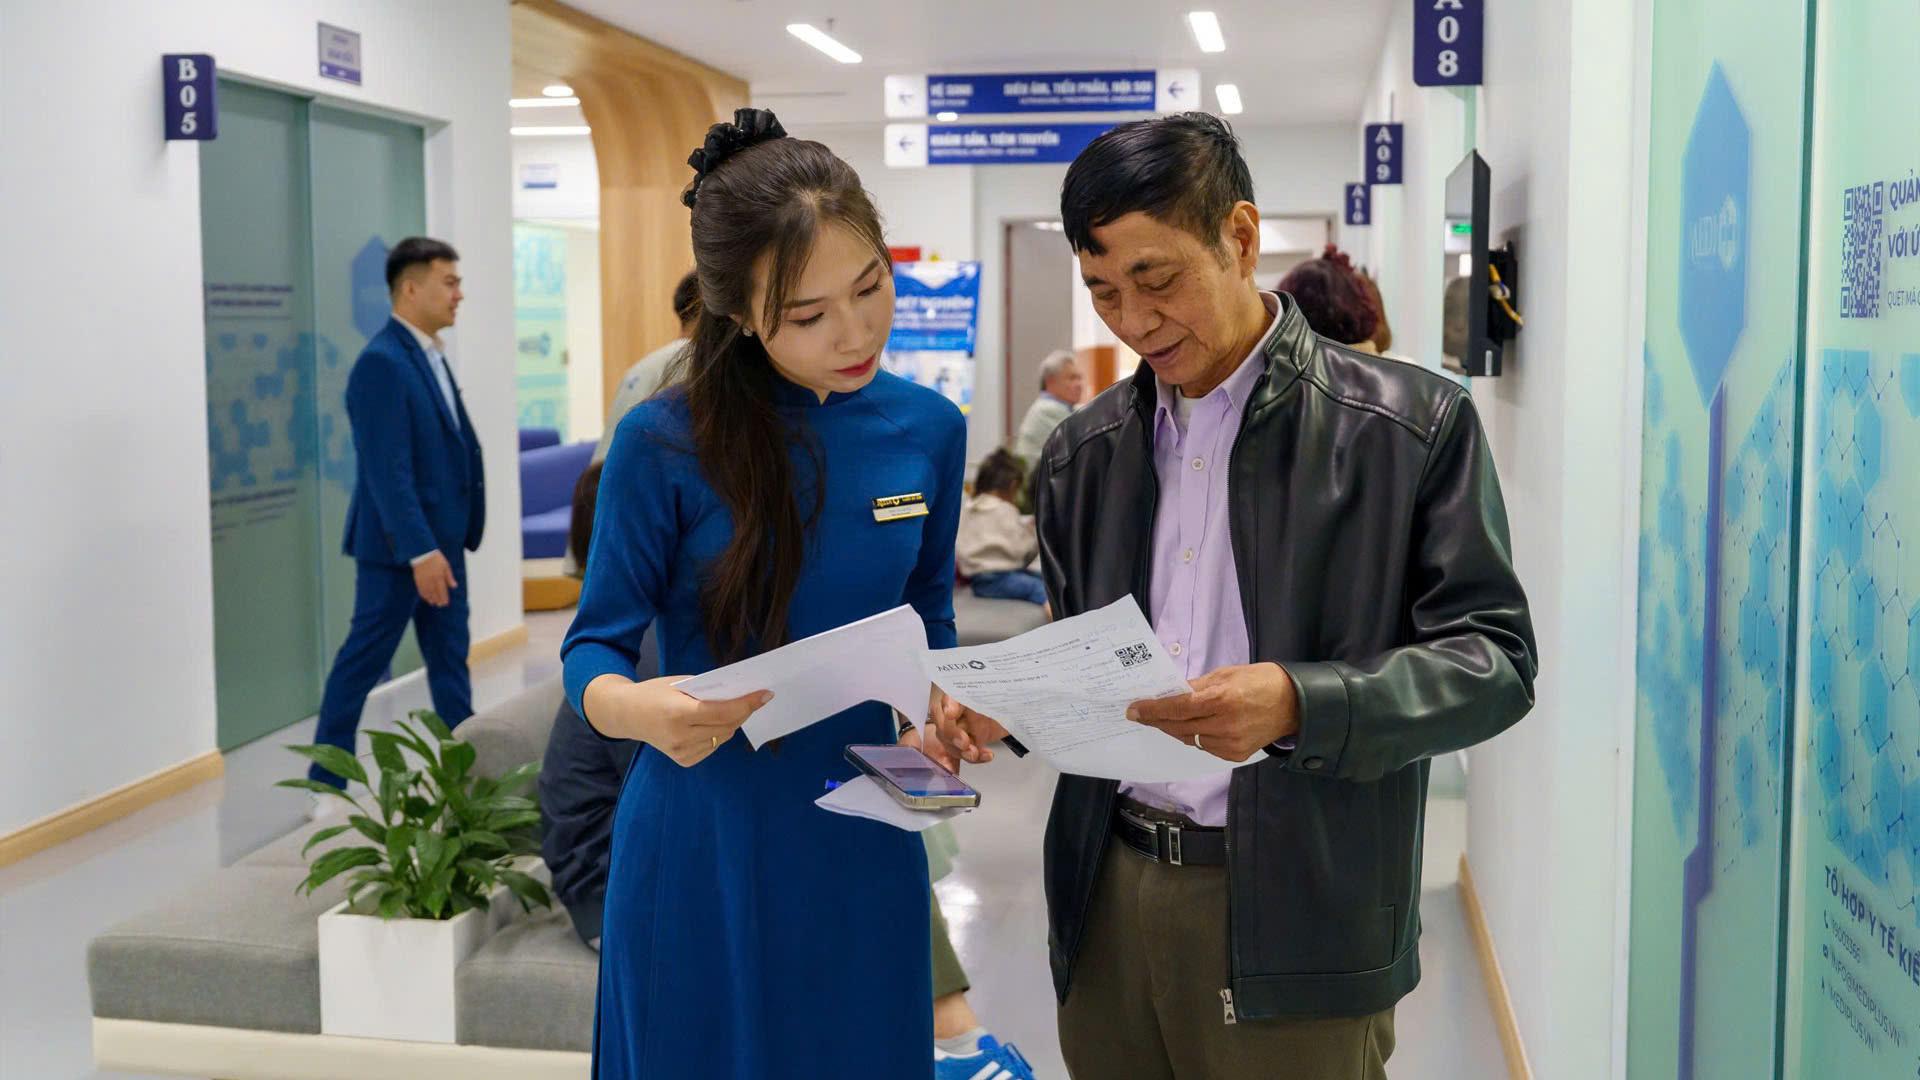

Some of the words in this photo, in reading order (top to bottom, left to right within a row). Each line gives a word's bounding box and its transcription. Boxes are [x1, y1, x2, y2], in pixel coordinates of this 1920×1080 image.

[178, 58, 198, 135] B05
[1375, 126, 1393, 181] A09
[1352, 185, 1365, 222] A10
[1888, 226, 1908, 258] VỚI
[1869, 911, 1876, 936] Y
[1880, 921, 1896, 958] TẾ
